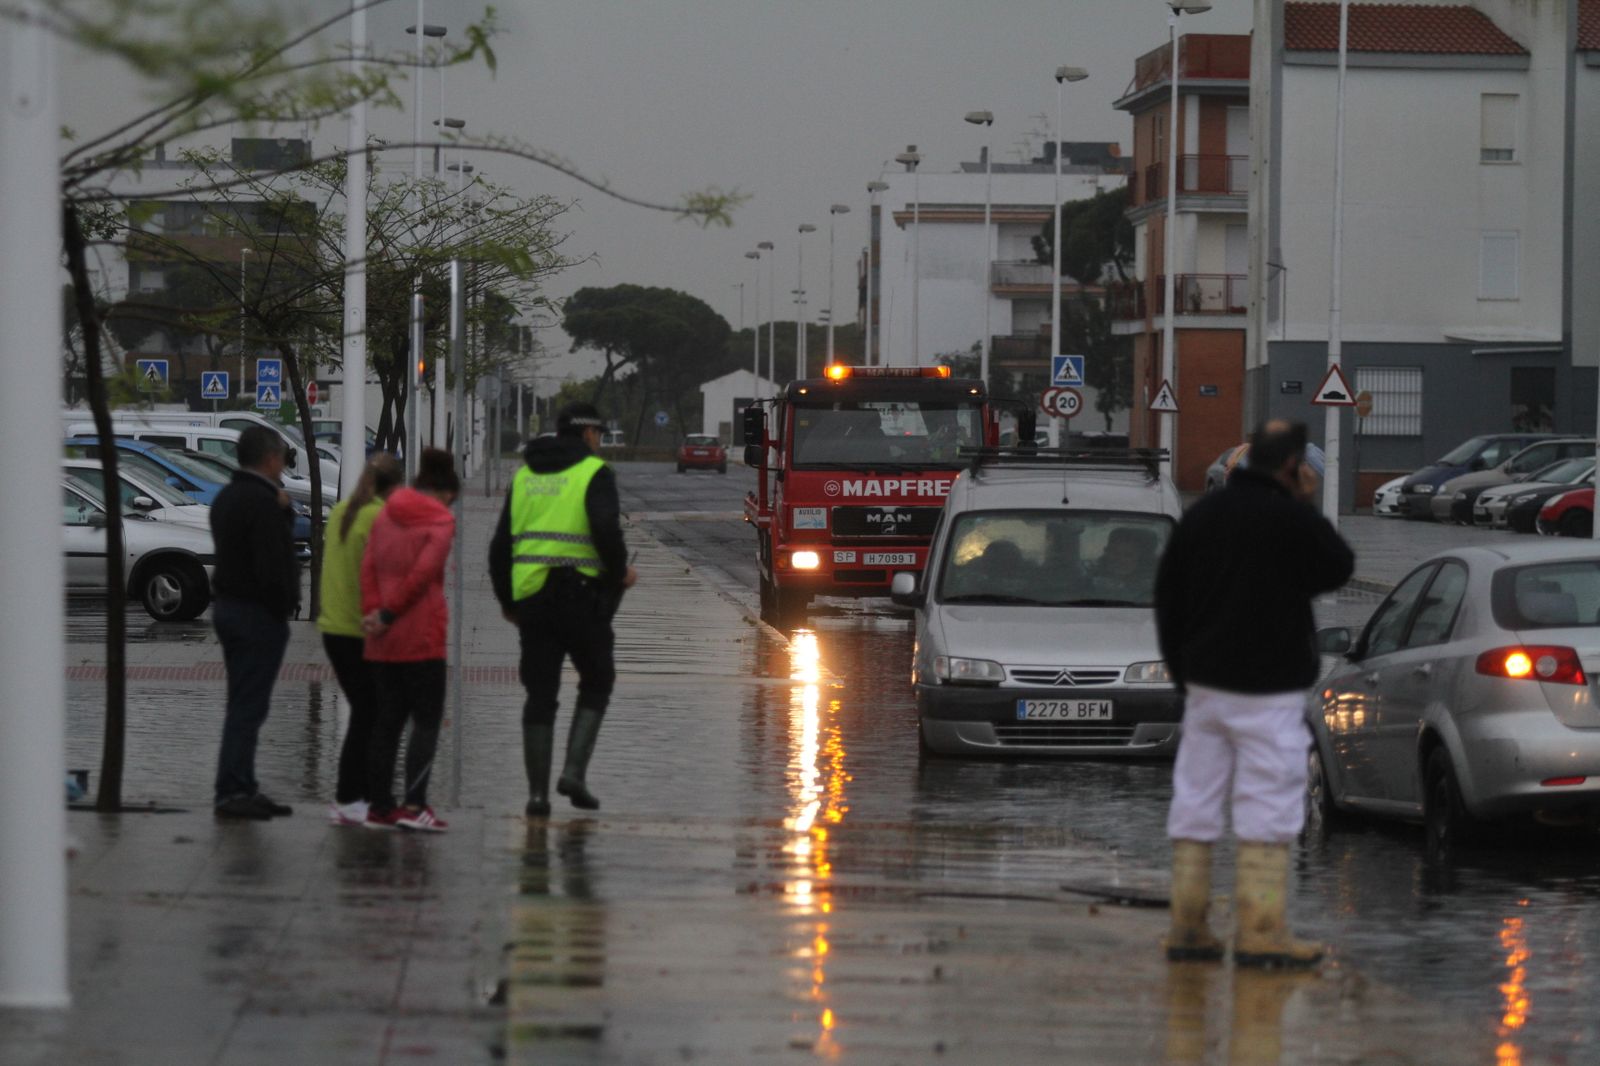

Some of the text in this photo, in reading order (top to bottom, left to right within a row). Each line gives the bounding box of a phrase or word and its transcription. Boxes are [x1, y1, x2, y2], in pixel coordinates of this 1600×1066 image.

[1059, 396, 1077, 409] 20
[843, 480, 950, 496] MAPFRE
[866, 514, 912, 522] MAN
[836, 553, 854, 562] SP
[869, 554, 914, 563] H 7099 T
[1027, 702, 1069, 717] 2278
[1077, 702, 1109, 717] BFM
